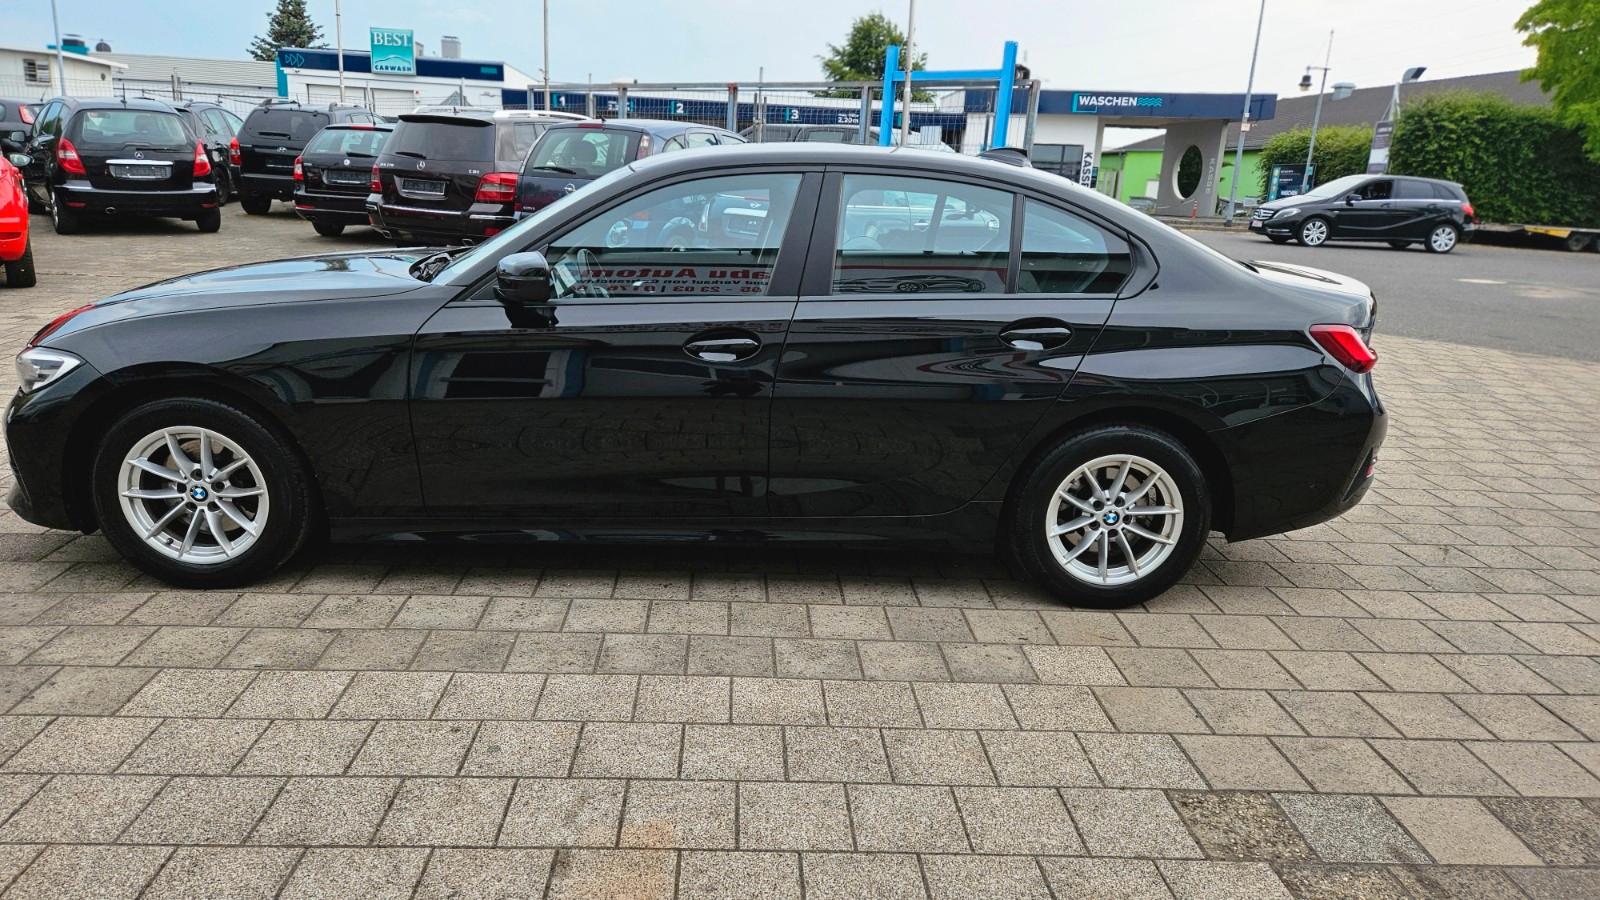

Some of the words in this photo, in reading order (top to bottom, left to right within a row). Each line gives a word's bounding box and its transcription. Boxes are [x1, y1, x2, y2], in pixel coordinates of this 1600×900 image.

[373, 31, 410, 47] BEST
[374, 64, 412, 72] CARWASH
[559, 96, 566, 107] 1
[1079, 95, 1138, 107] WASCHEN
[676, 103, 684, 114] 2
[791, 109, 800, 120] 3
